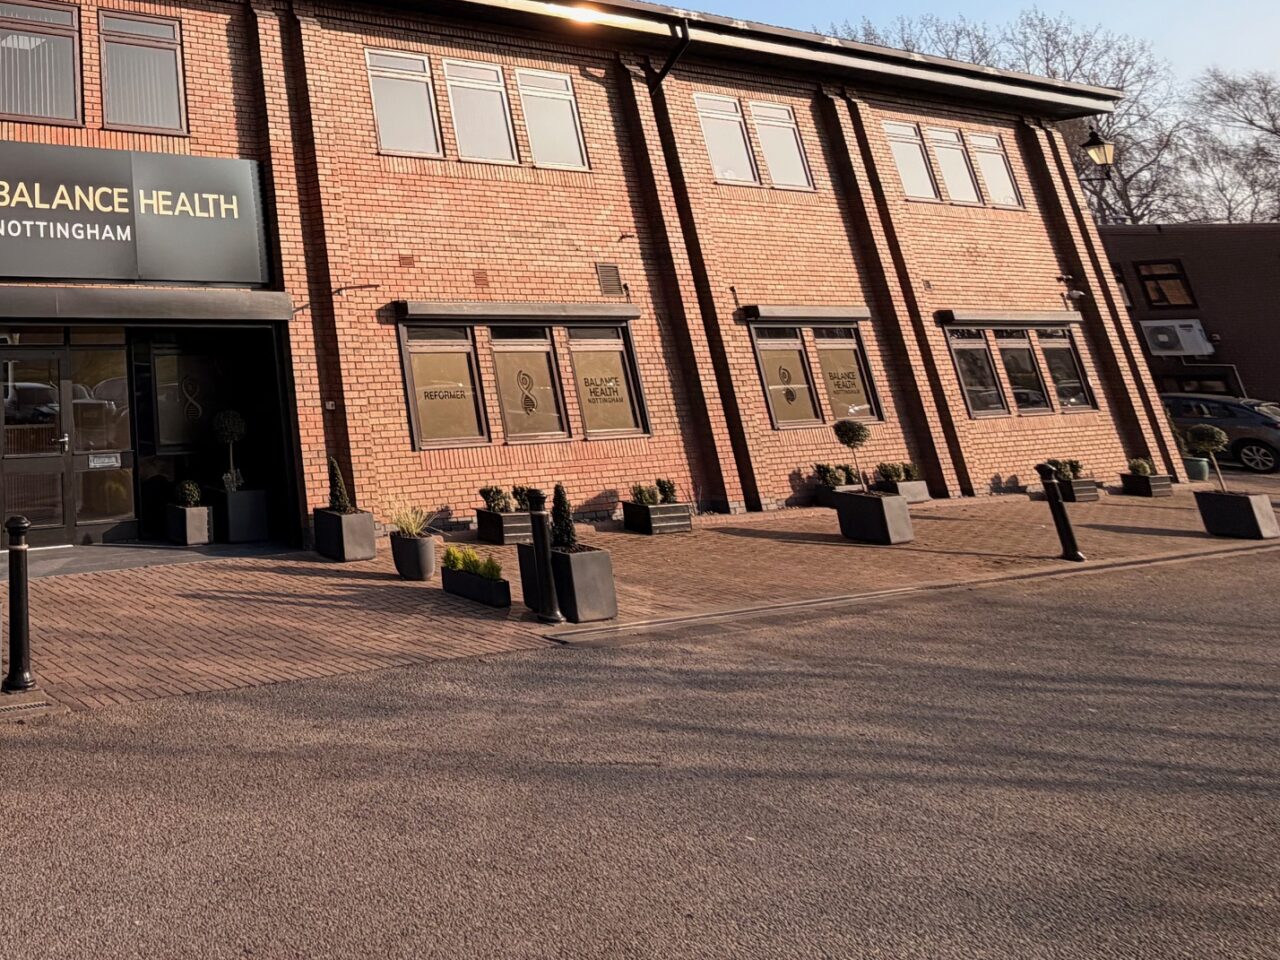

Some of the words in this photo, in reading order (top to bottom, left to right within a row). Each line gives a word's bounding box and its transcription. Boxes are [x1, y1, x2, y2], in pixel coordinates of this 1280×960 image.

[138, 189, 239, 219] HEALTH
[583, 376, 621, 387] BALANCE
[423, 390, 466, 400] REFORMER
[589, 387, 619, 397] HEALTH
